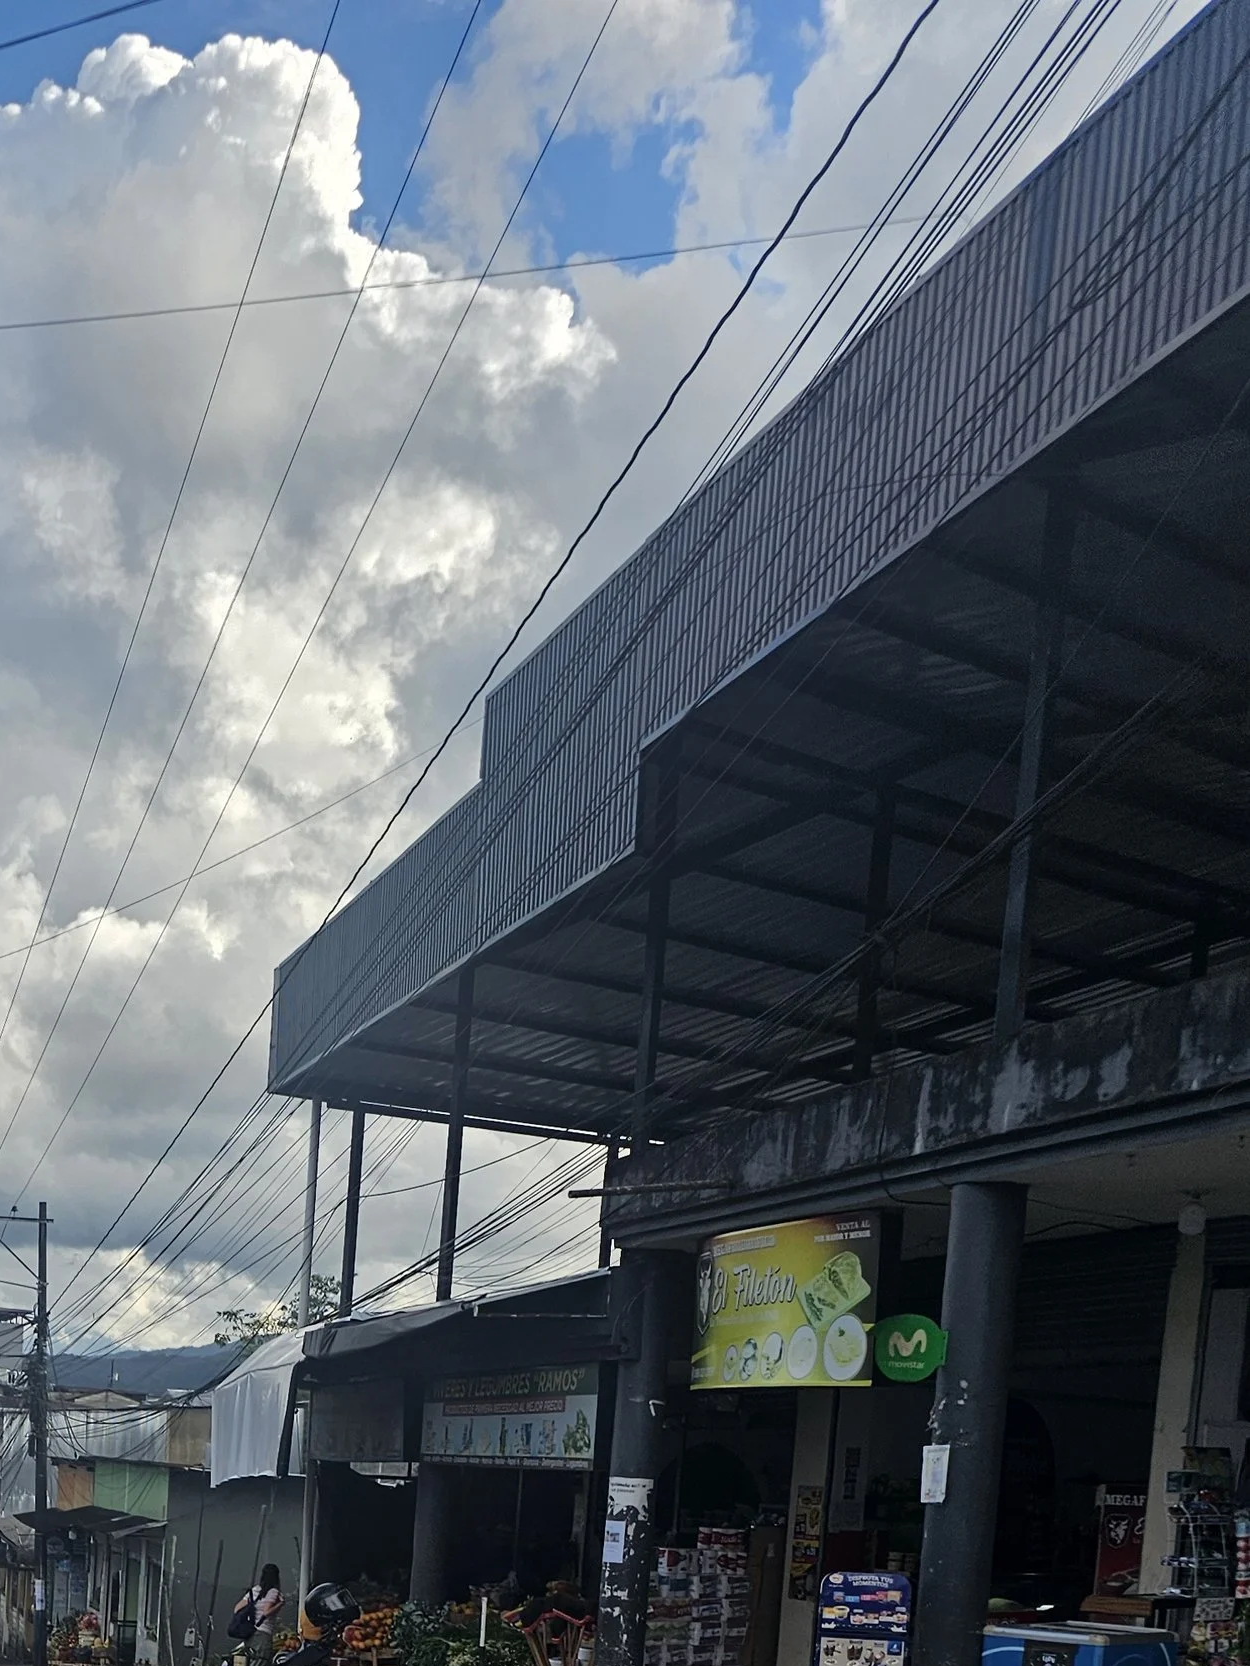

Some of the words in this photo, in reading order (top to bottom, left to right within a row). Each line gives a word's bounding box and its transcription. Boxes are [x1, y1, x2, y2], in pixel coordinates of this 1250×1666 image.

[734, 1263, 797, 1311] Filetón
[888, 1360, 926, 1369] movistar
[1105, 1494, 1147, 1506] MEGAF
